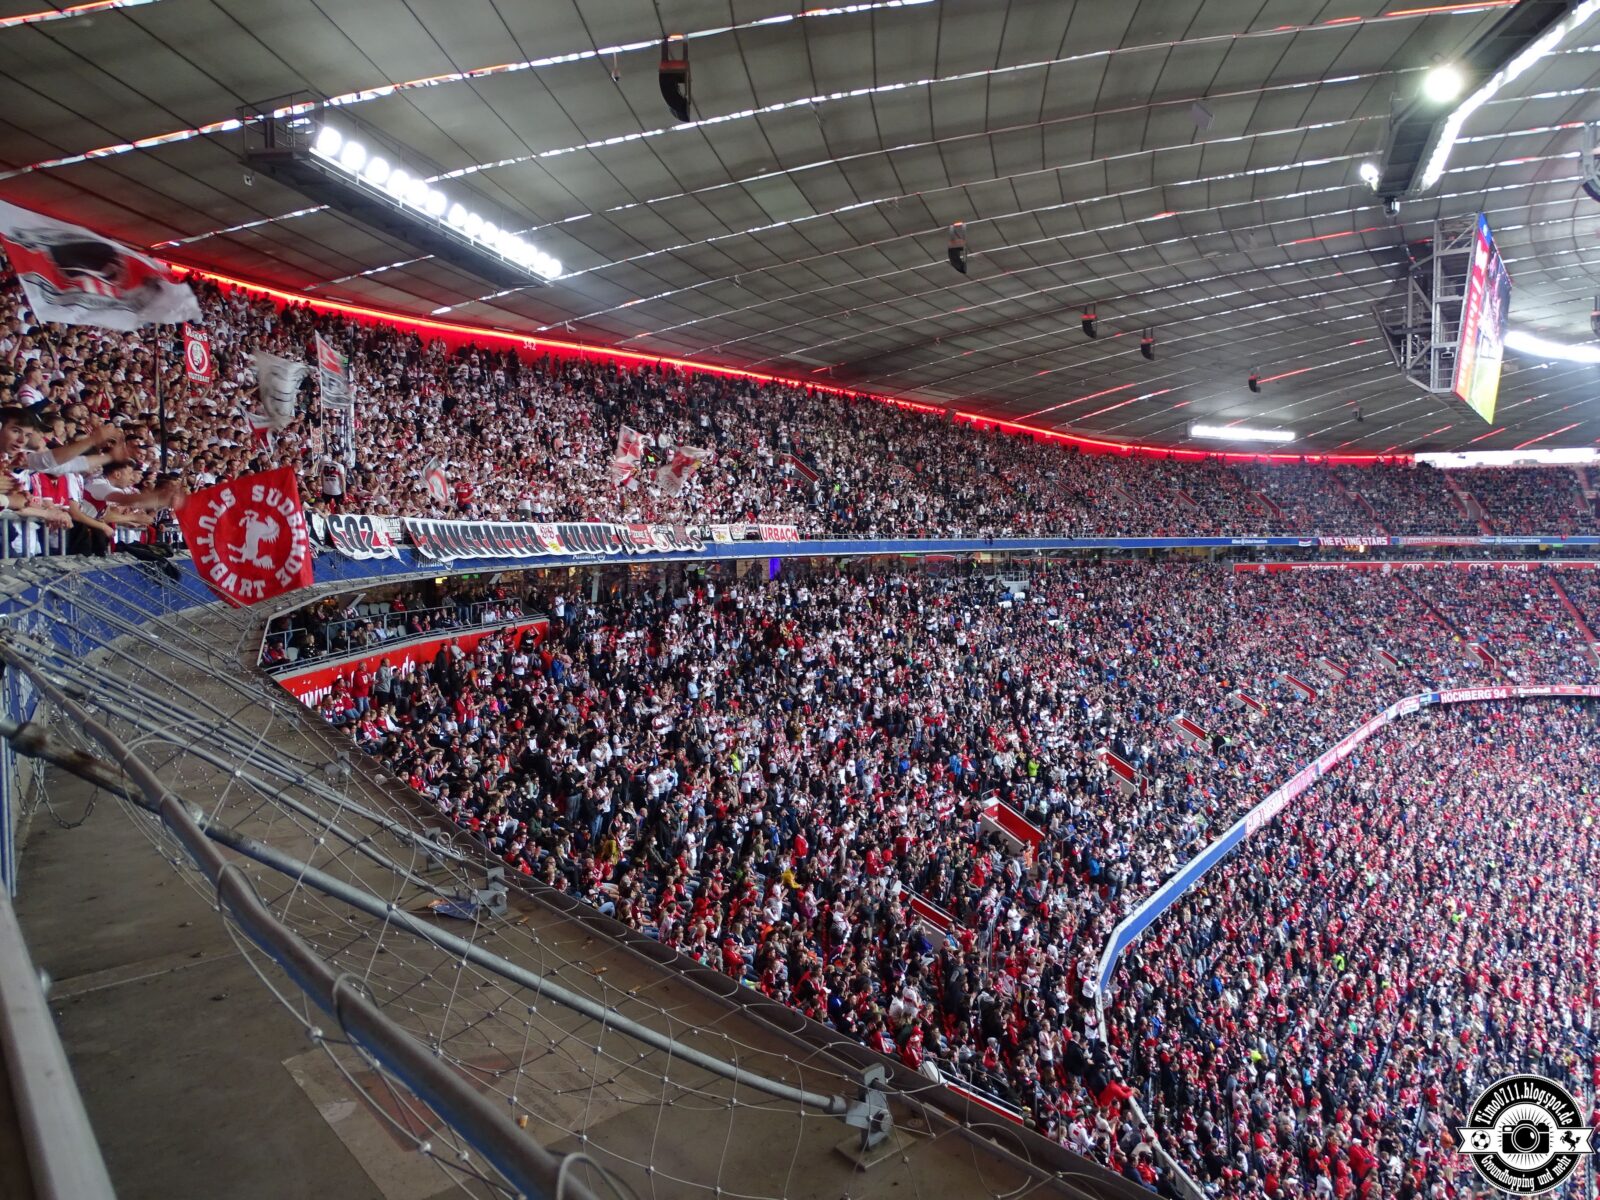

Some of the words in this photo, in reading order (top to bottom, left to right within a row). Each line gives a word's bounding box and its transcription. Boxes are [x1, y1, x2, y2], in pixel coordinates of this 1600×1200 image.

[196, 488, 267, 598] STUTTGART
[557, 525, 620, 551] KURVE
[761, 526, 799, 541] URBACH
[1318, 537, 1335, 546] THE
[1335, 537, 1362, 546] FLYING
[1362, 537, 1388, 546] STARS
